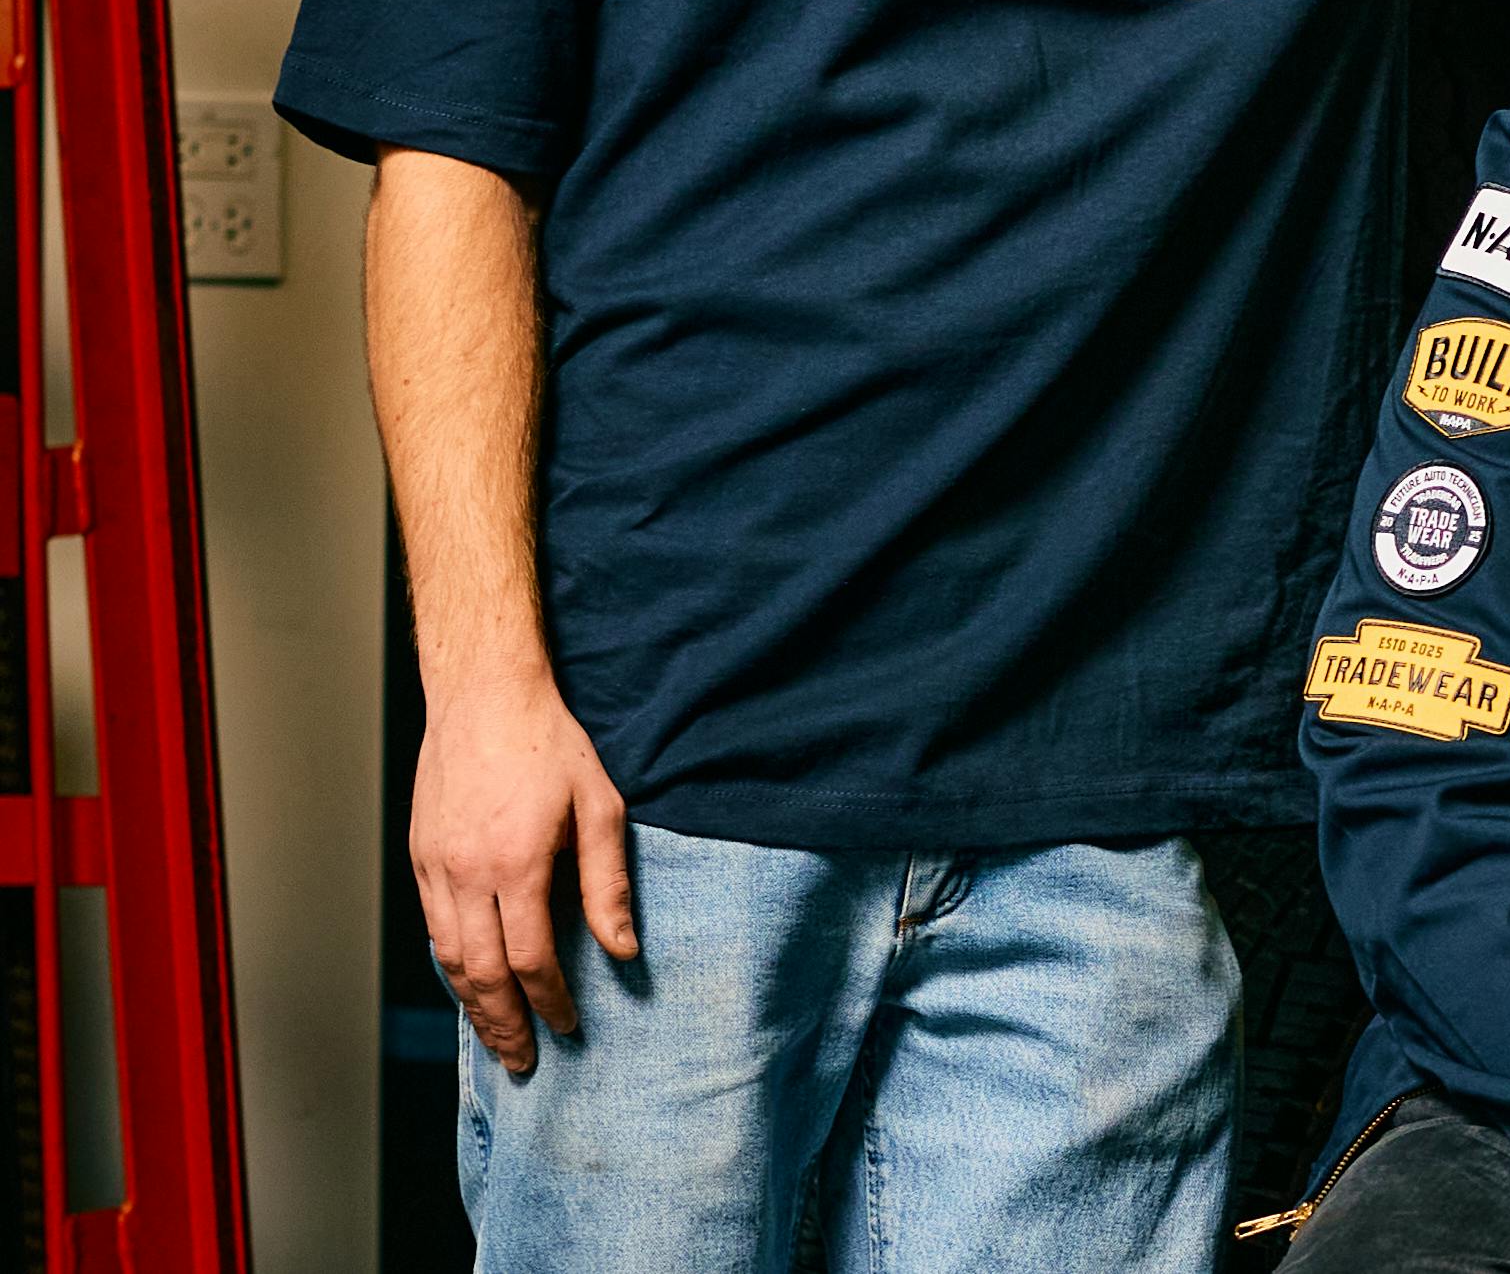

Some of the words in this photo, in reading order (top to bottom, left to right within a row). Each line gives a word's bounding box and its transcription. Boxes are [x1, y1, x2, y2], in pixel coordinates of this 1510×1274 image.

[1432, 385, 1448, 403] TO
[1454, 389, 1498, 414] WORK
[1439, 414, 1472, 431] NAPA
[1391, 475, 1421, 508] FUTURE
[1424, 470, 1446, 482] AUTO
[1449, 473, 1482, 520] TECHNICIAN
[1380, 516, 1394, 528] 20
[1409, 507, 1460, 532] TRADE
[1407, 524, 1453, 549] WEAR
[1468, 530, 1482, 543] 25
[1378, 637, 1405, 652] ESTD
[1410, 641, 1444, 659] 2025
[1323, 655, 1498, 712] TRADEWEAR
